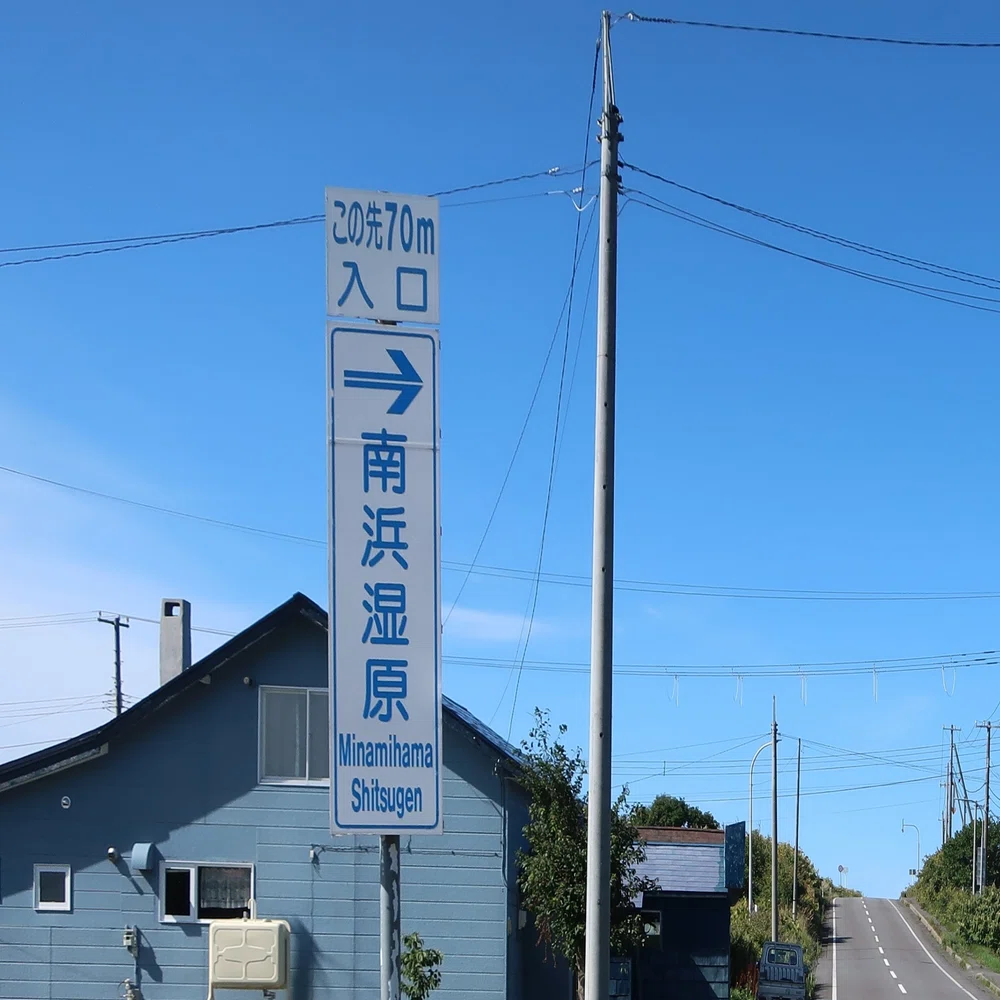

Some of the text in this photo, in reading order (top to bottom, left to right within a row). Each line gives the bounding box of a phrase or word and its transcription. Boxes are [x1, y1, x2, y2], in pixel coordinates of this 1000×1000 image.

[333, 200, 435, 255] この先70m
[337, 261, 428, 312] 入口
[361, 427, 410, 722] 南浜湿原
[339, 733, 433, 768] Minamihama
[351, 777, 422, 819] Shitsugen
